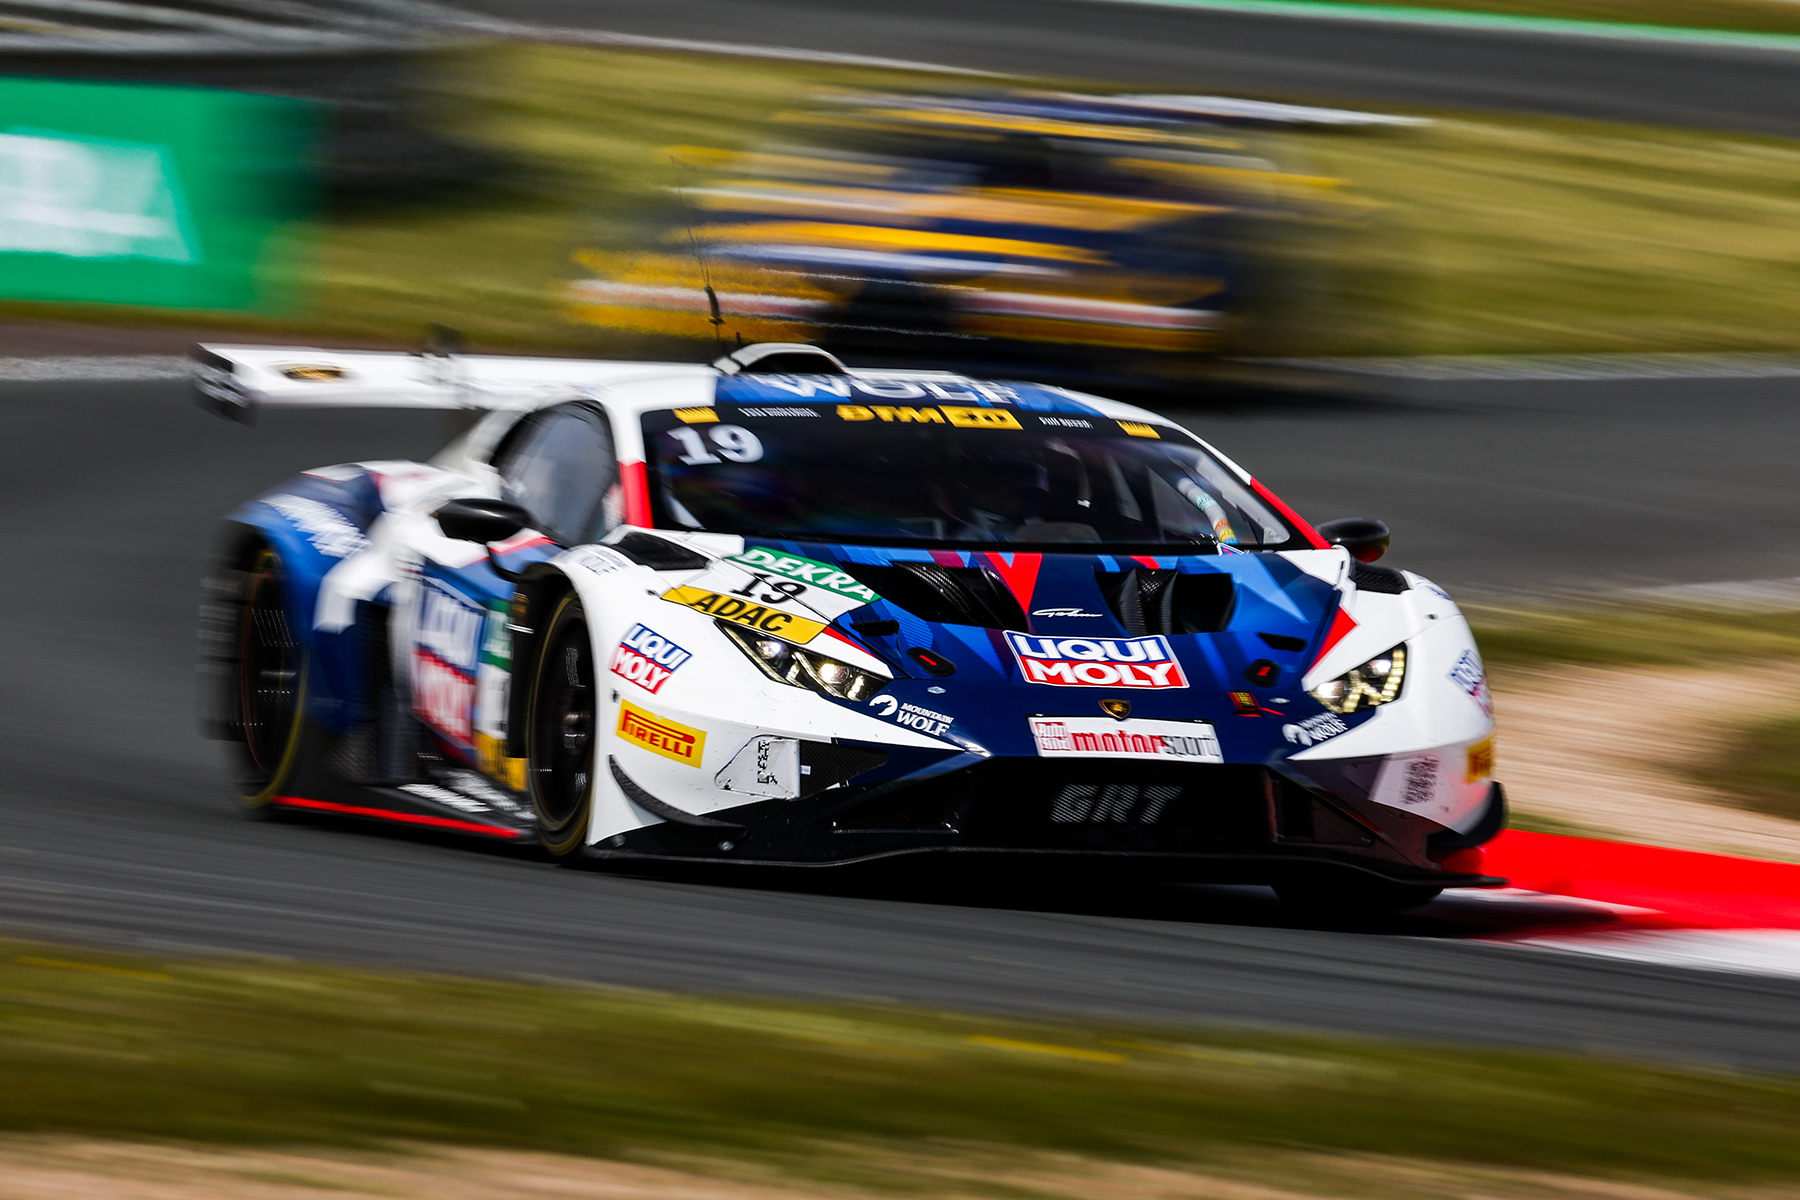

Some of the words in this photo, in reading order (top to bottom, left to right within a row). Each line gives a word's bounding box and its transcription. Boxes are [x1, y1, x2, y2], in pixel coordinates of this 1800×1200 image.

[836, 404, 947, 424] DTM
[665, 424, 765, 466] 19
[729, 572, 808, 605] 19
[737, 548, 877, 601] DEKRA
[688, 594, 794, 632] ADAC
[622, 624, 691, 670] LIQUI
[1012, 634, 1166, 662] LIQUI
[612, 647, 673, 691] MOLY
[1024, 660, 1184, 687] MOLY
[896, 709, 950, 737] WOLF
[900, 702, 955, 724] MOUNTAIN
[621, 708, 696, 758] PIRELLI
